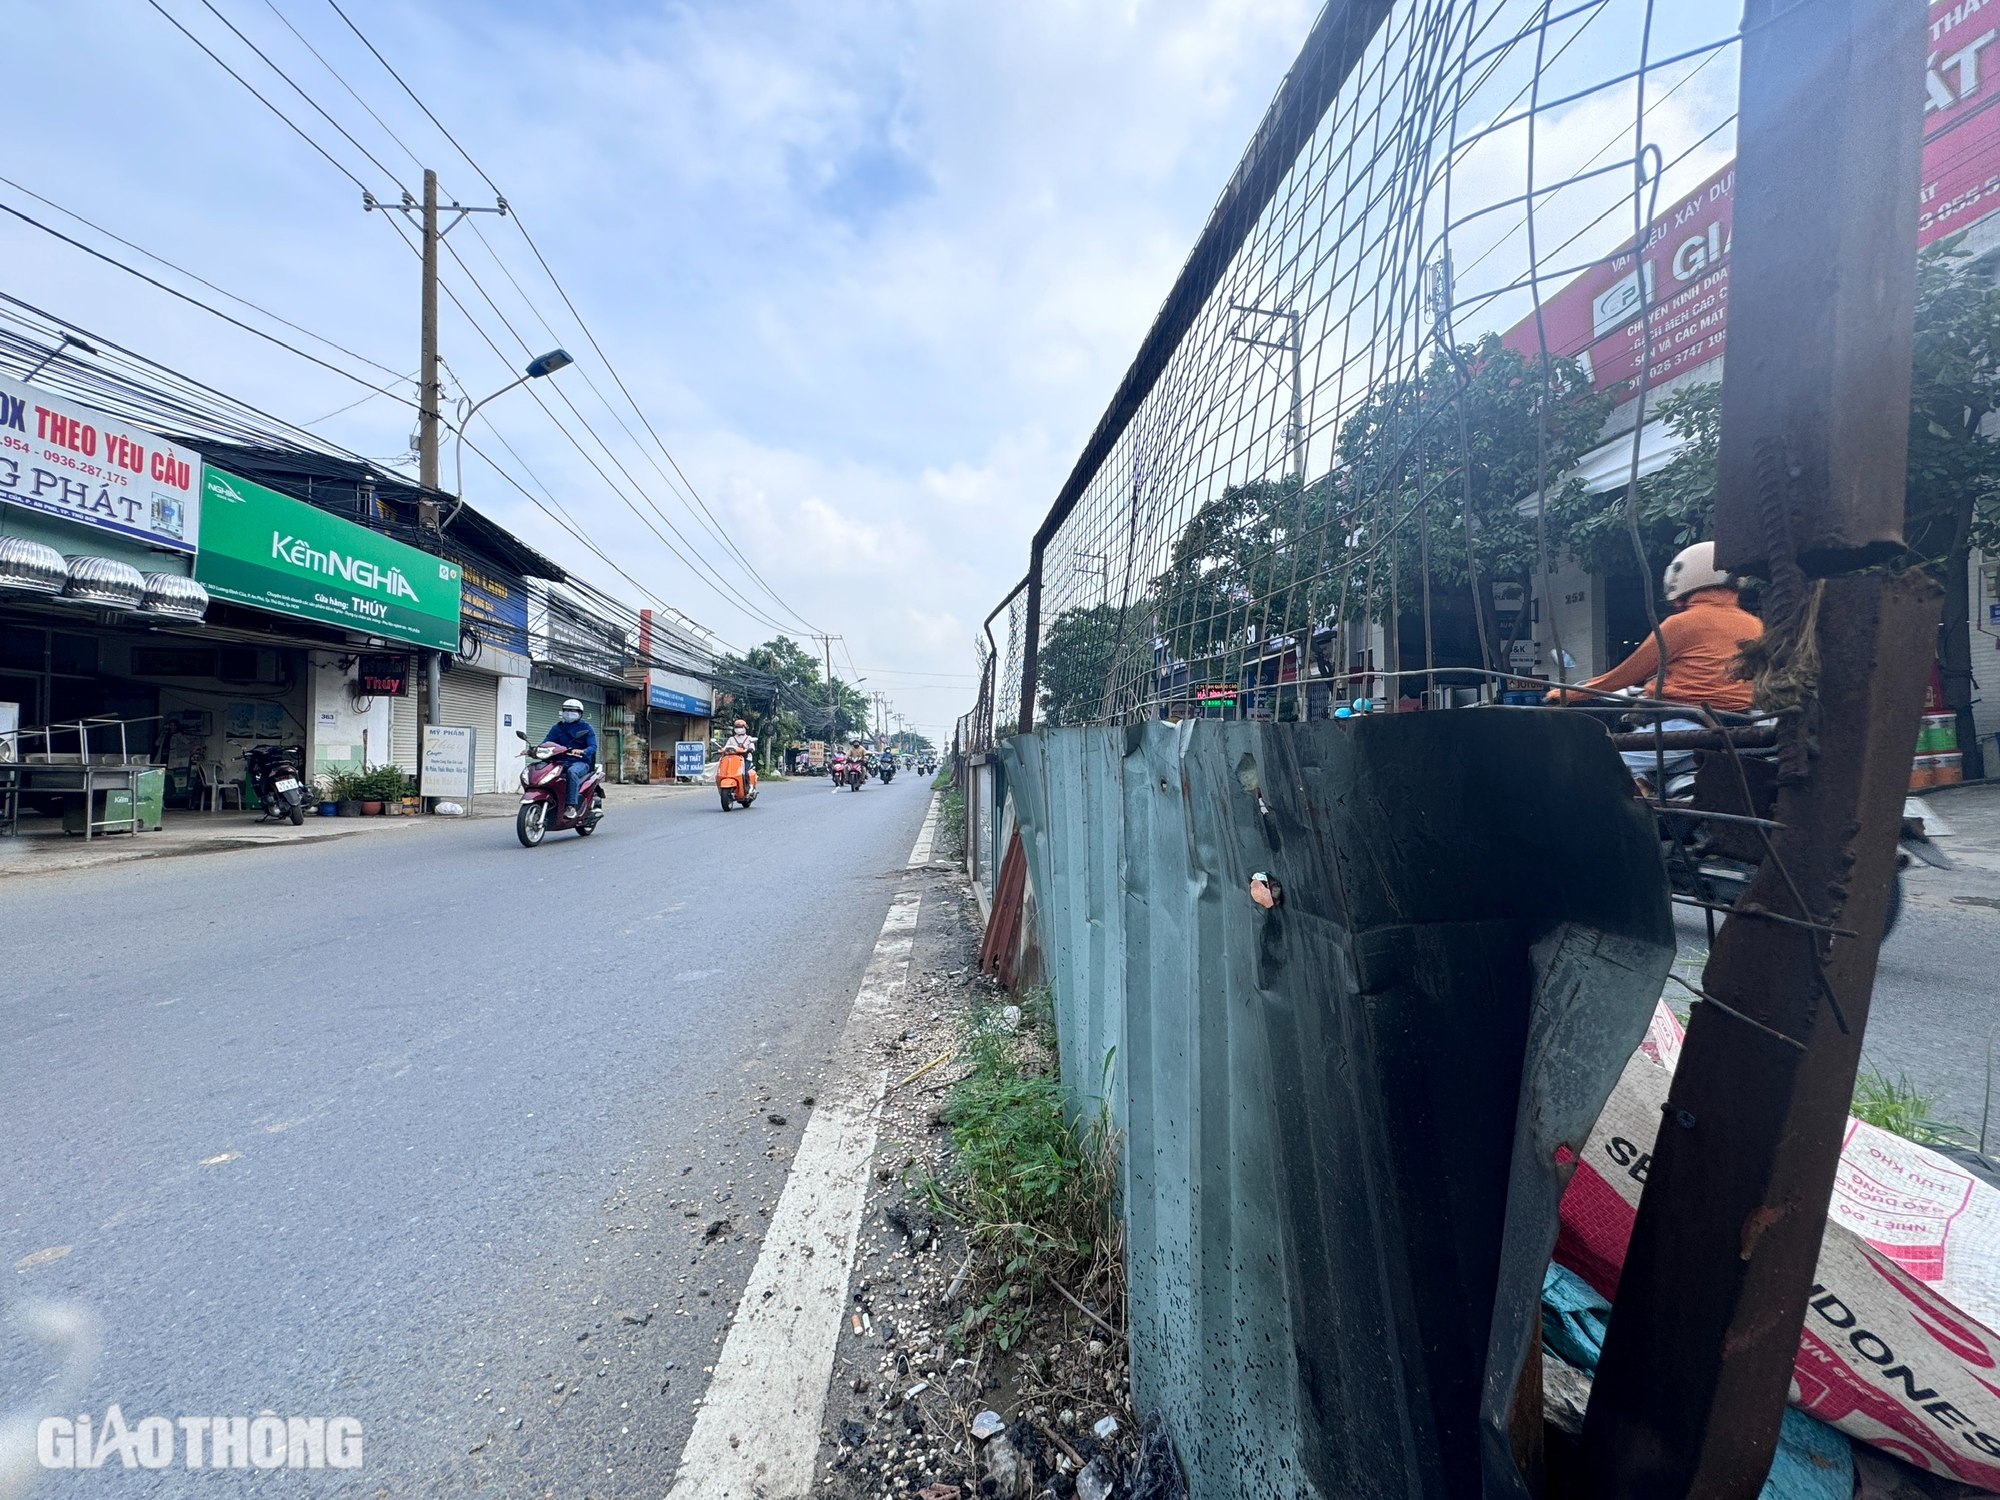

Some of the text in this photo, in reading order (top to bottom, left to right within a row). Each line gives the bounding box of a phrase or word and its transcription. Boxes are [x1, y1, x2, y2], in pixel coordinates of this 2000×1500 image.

[1929, 0, 1991, 41] THA
[1674, 195, 1703, 229] XÂY
[1709, 170, 1735, 203] DỰ
[1672, 220, 1732, 281] GI
[1672, 284, 1700, 310] KINH
[1658, 336, 1672, 354] VÀ
[1675, 322, 1698, 344] CÁC
[1674, 340, 1704, 366] 3747
[35, 405, 97, 457] THEO
[104, 433, 144, 474] YÊU
[151, 447, 191, 491] CẦU
[43, 449, 128, 487] 0936.287.175
[29, 467, 143, 523] PHÁT
[351, 596, 388, 619] THÚY
[1565, 592, 1585, 604] 252
[364, 676, 400, 693] Thúy
